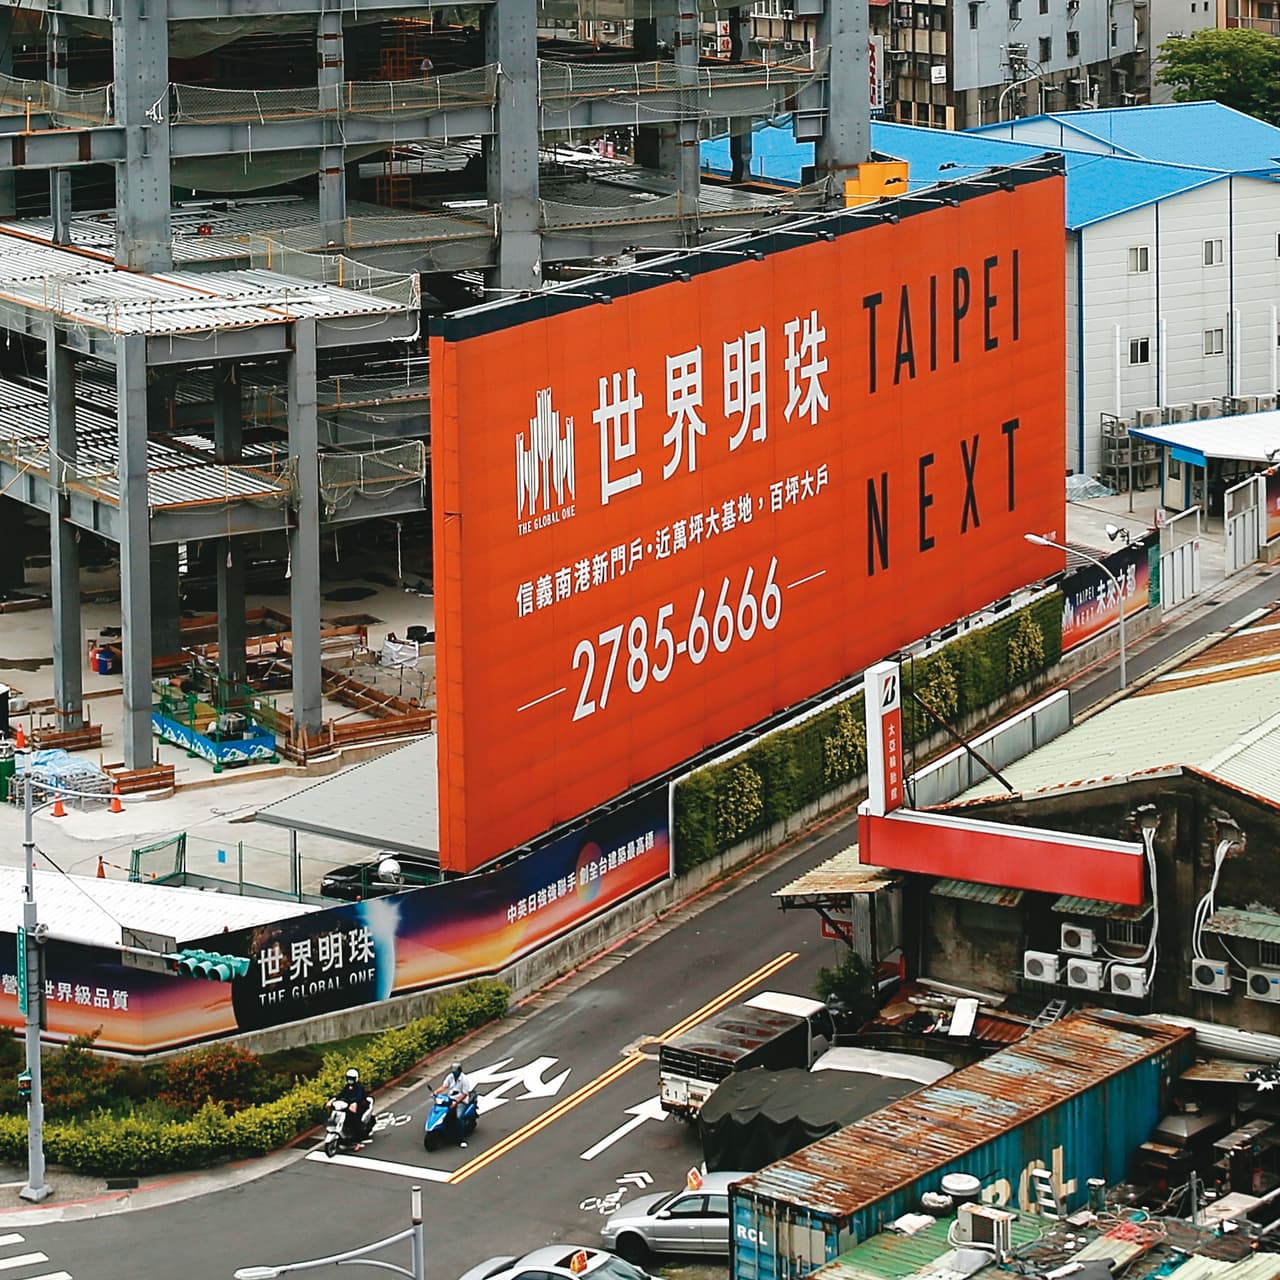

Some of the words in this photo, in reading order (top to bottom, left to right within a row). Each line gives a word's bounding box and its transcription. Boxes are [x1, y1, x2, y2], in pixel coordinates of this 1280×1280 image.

[862, 249, 1020, 394] TAIPEI
[592, 310, 830, 506] 世界明珠
[518, 520, 532, 536] THE
[533, 511, 560, 531] GLOBAL
[561, 504, 576, 520] ONE
[867, 418, 1020, 577] NEXT
[572, 556, 784, 723] 2785-6666
[258, 926, 376, 988] 世界明珠
[259, 989, 286, 1007] THE
[292, 975, 342, 1000] GLOBAL
[349, 967, 376, 985] ONE
[2, 972, 129, 1012] 營世界級品質
[737, 1224, 768, 1246] RCL
